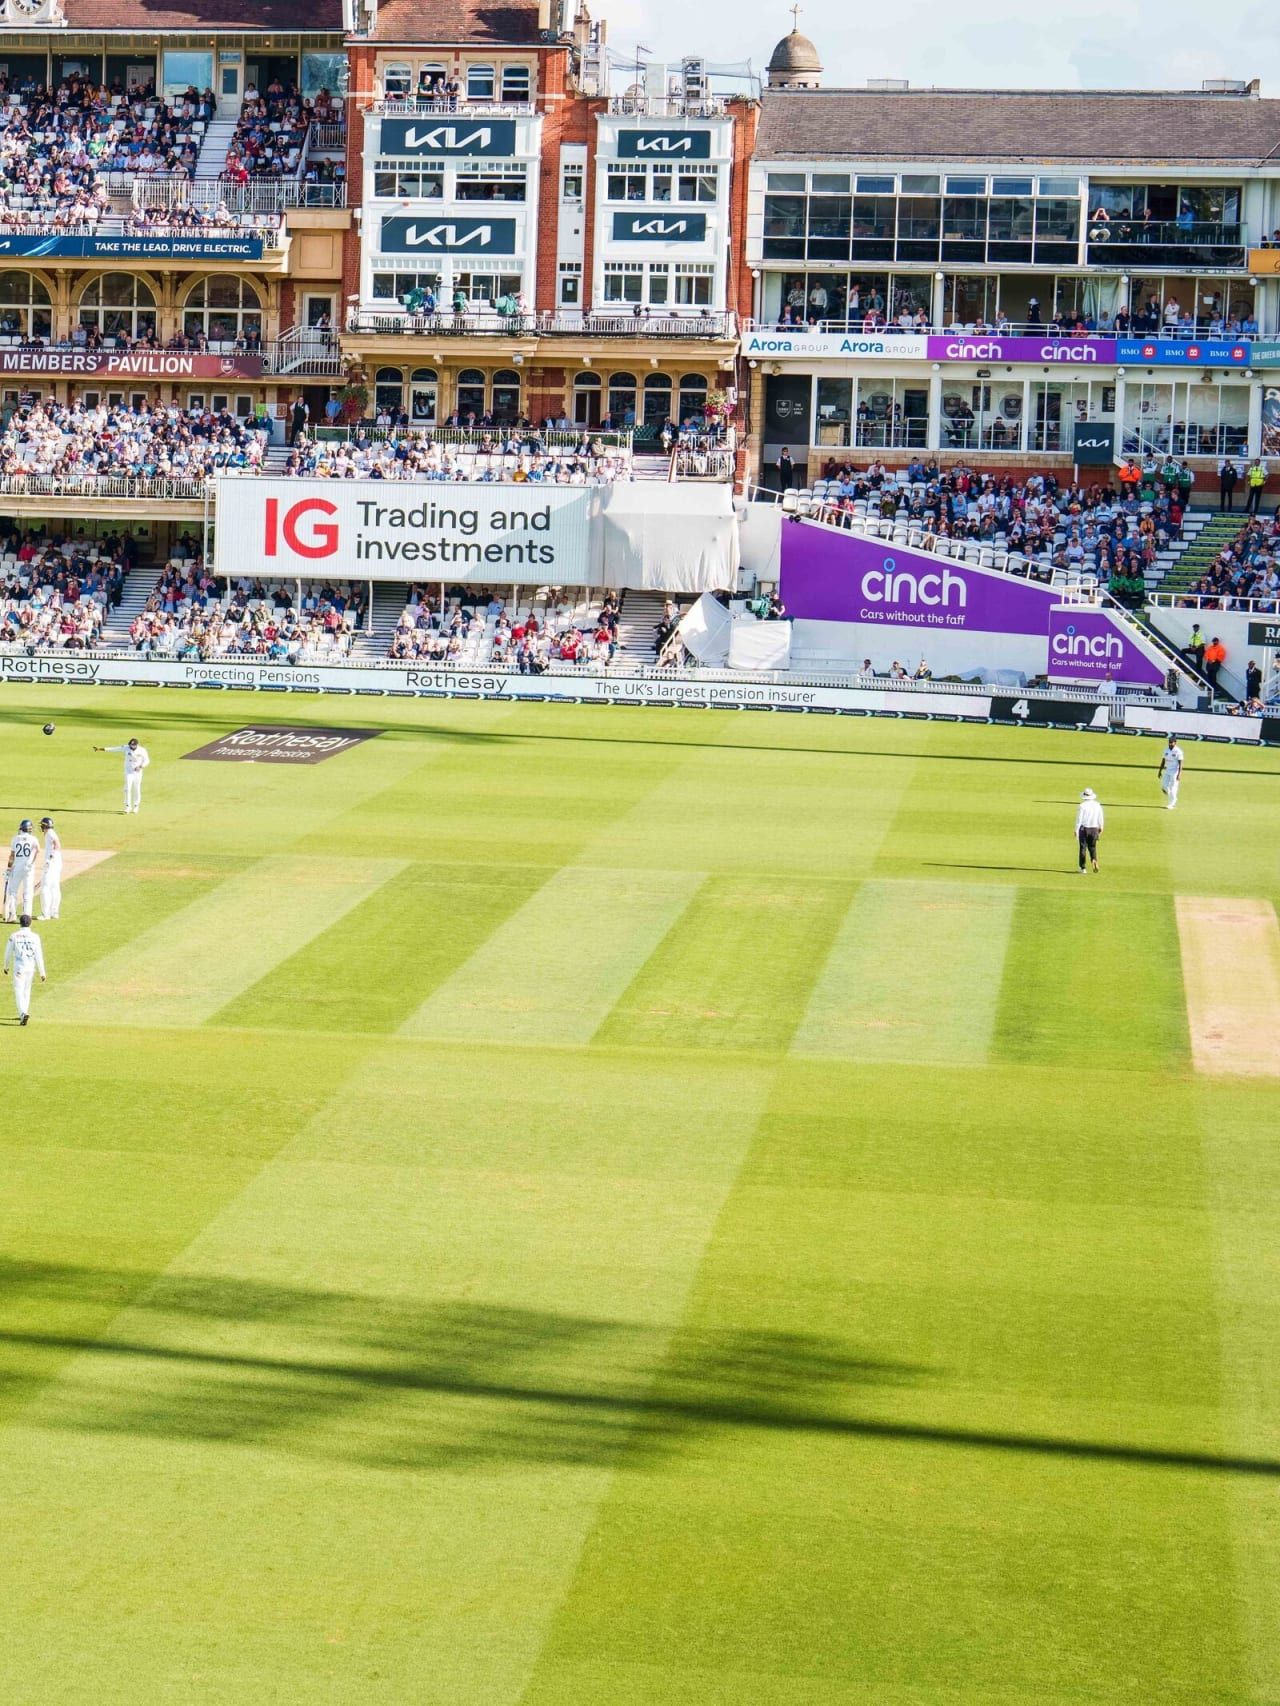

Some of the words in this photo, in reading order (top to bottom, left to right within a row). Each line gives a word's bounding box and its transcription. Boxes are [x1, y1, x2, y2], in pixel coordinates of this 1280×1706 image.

[405, 126, 491, 148] KIA
[637, 136, 691, 151] KIA
[405, 224, 491, 246] KIA
[632, 219, 687, 234] KIA
[95, 242, 120, 251] TAKE
[122, 242, 141, 251] THE
[143, 243, 170, 252] LEAD.
[172, 243, 201, 252] DRIVE
[203, 244, 252, 253] ELECTRIC.
[749, 338, 792, 351] Arora
[794, 344, 829, 352] GROUP
[840, 339, 884, 353] Arora
[885, 345, 921, 354] GROUP
[946, 338, 1002, 359] cinch
[1041, 340, 1097, 361] cinch
[1209, 350, 1229, 358] BMO
[108, 356, 192, 373] PAVILION
[1077, 438, 1110, 448] KIA
[356, 500, 478, 536] Trading
[490, 505, 551, 531] and
[264, 498, 339, 559] IG
[356, 533, 555, 563] investments
[861, 557, 967, 607] cinch
[860, 608, 884, 619] Cars
[886, 610, 925, 623] without
[927, 613, 944, 624] the
[946, 614, 966, 625] faff
[1052, 625, 1123, 658] cinch
[2, 658, 100, 679] Rothesay
[1069, 659, 1095, 668] without
[1095, 661, 1108, 669] the
[1109, 662, 1122, 670] faff
[185, 666, 255, 684] Protecting
[259, 669, 320, 683] Pensions
[406, 672, 508, 694] Rothesay
[595, 682, 620, 695] The
[657, 683, 706, 700] largest
[709, 686, 764, 703] pension
[768, 688, 817, 703] insurer
[1011, 700, 1030, 719] 4
[220, 730, 361, 752] Rothesay
[15, 842, 31, 858] 26
